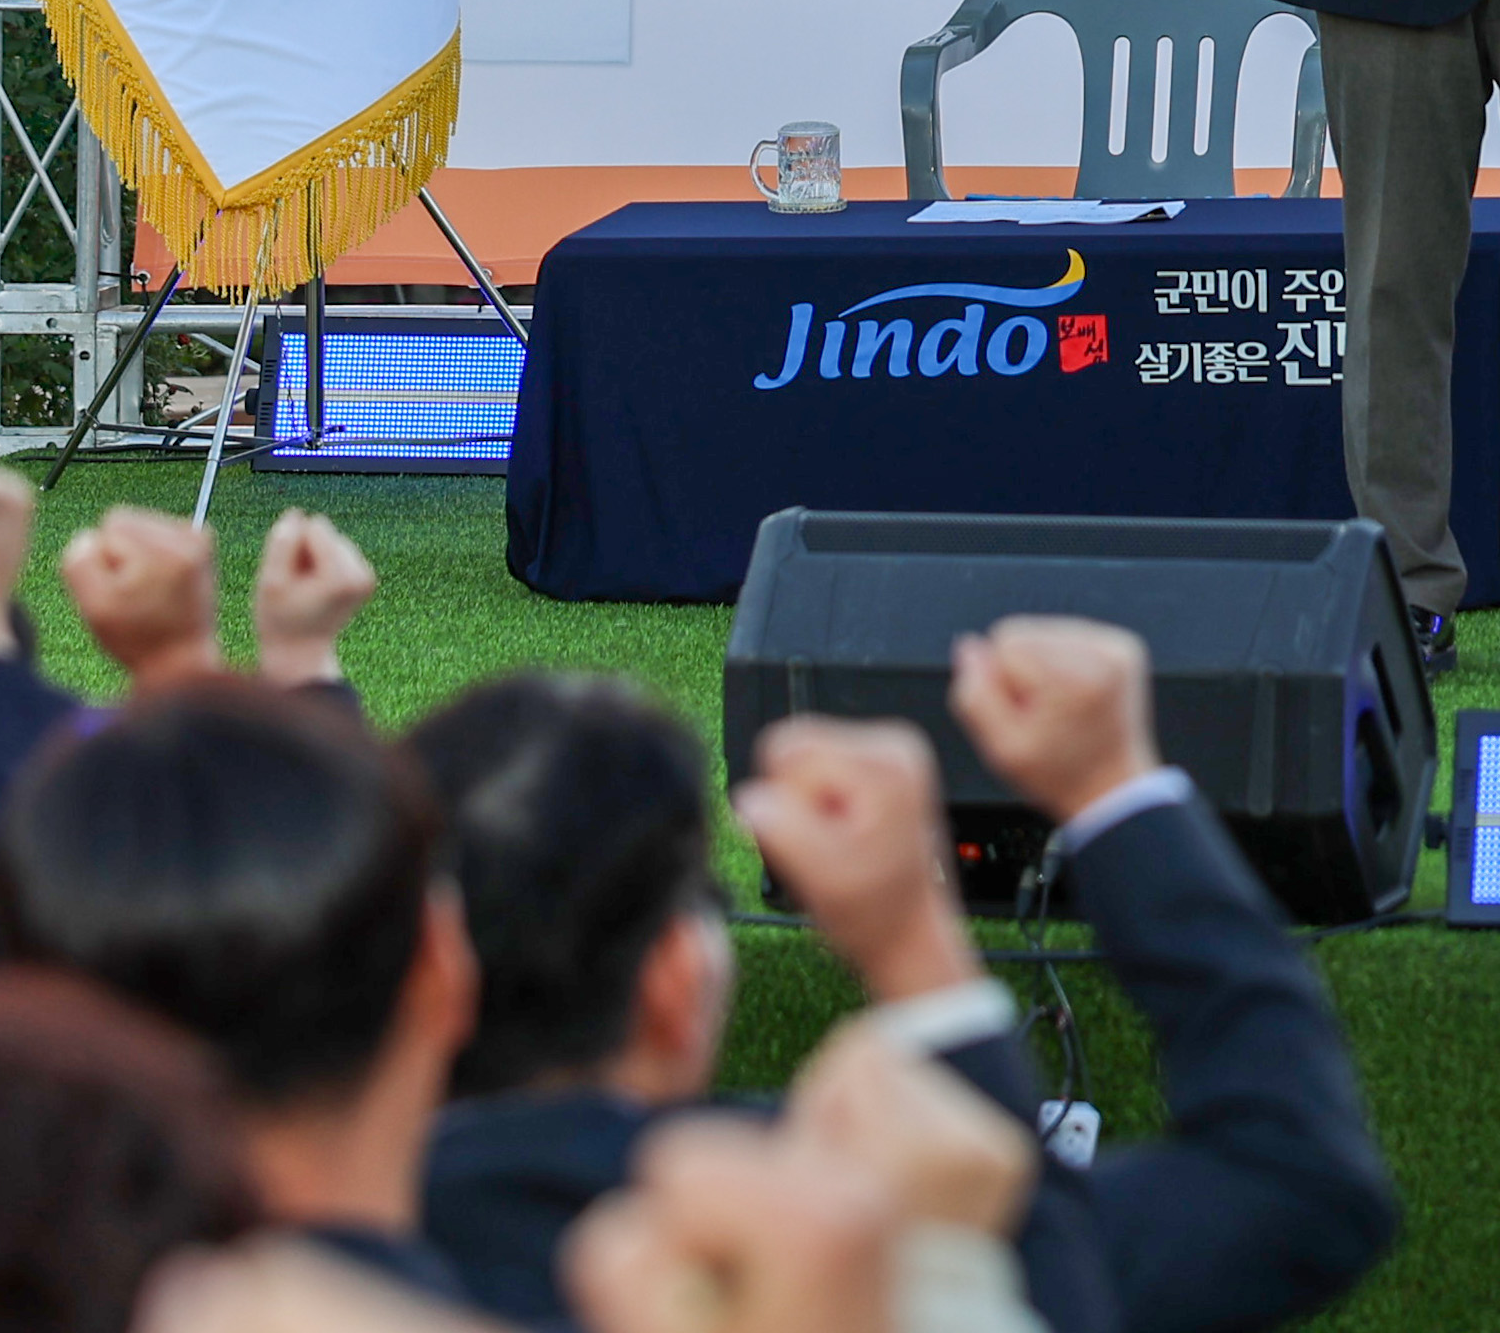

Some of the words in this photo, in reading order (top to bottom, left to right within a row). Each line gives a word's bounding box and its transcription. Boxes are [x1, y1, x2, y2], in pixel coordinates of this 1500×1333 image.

[1153, 268, 1268, 314] 군민이
[753, 302, 1048, 390] Jindo
[1134, 341, 1270, 384] 살기좋은
